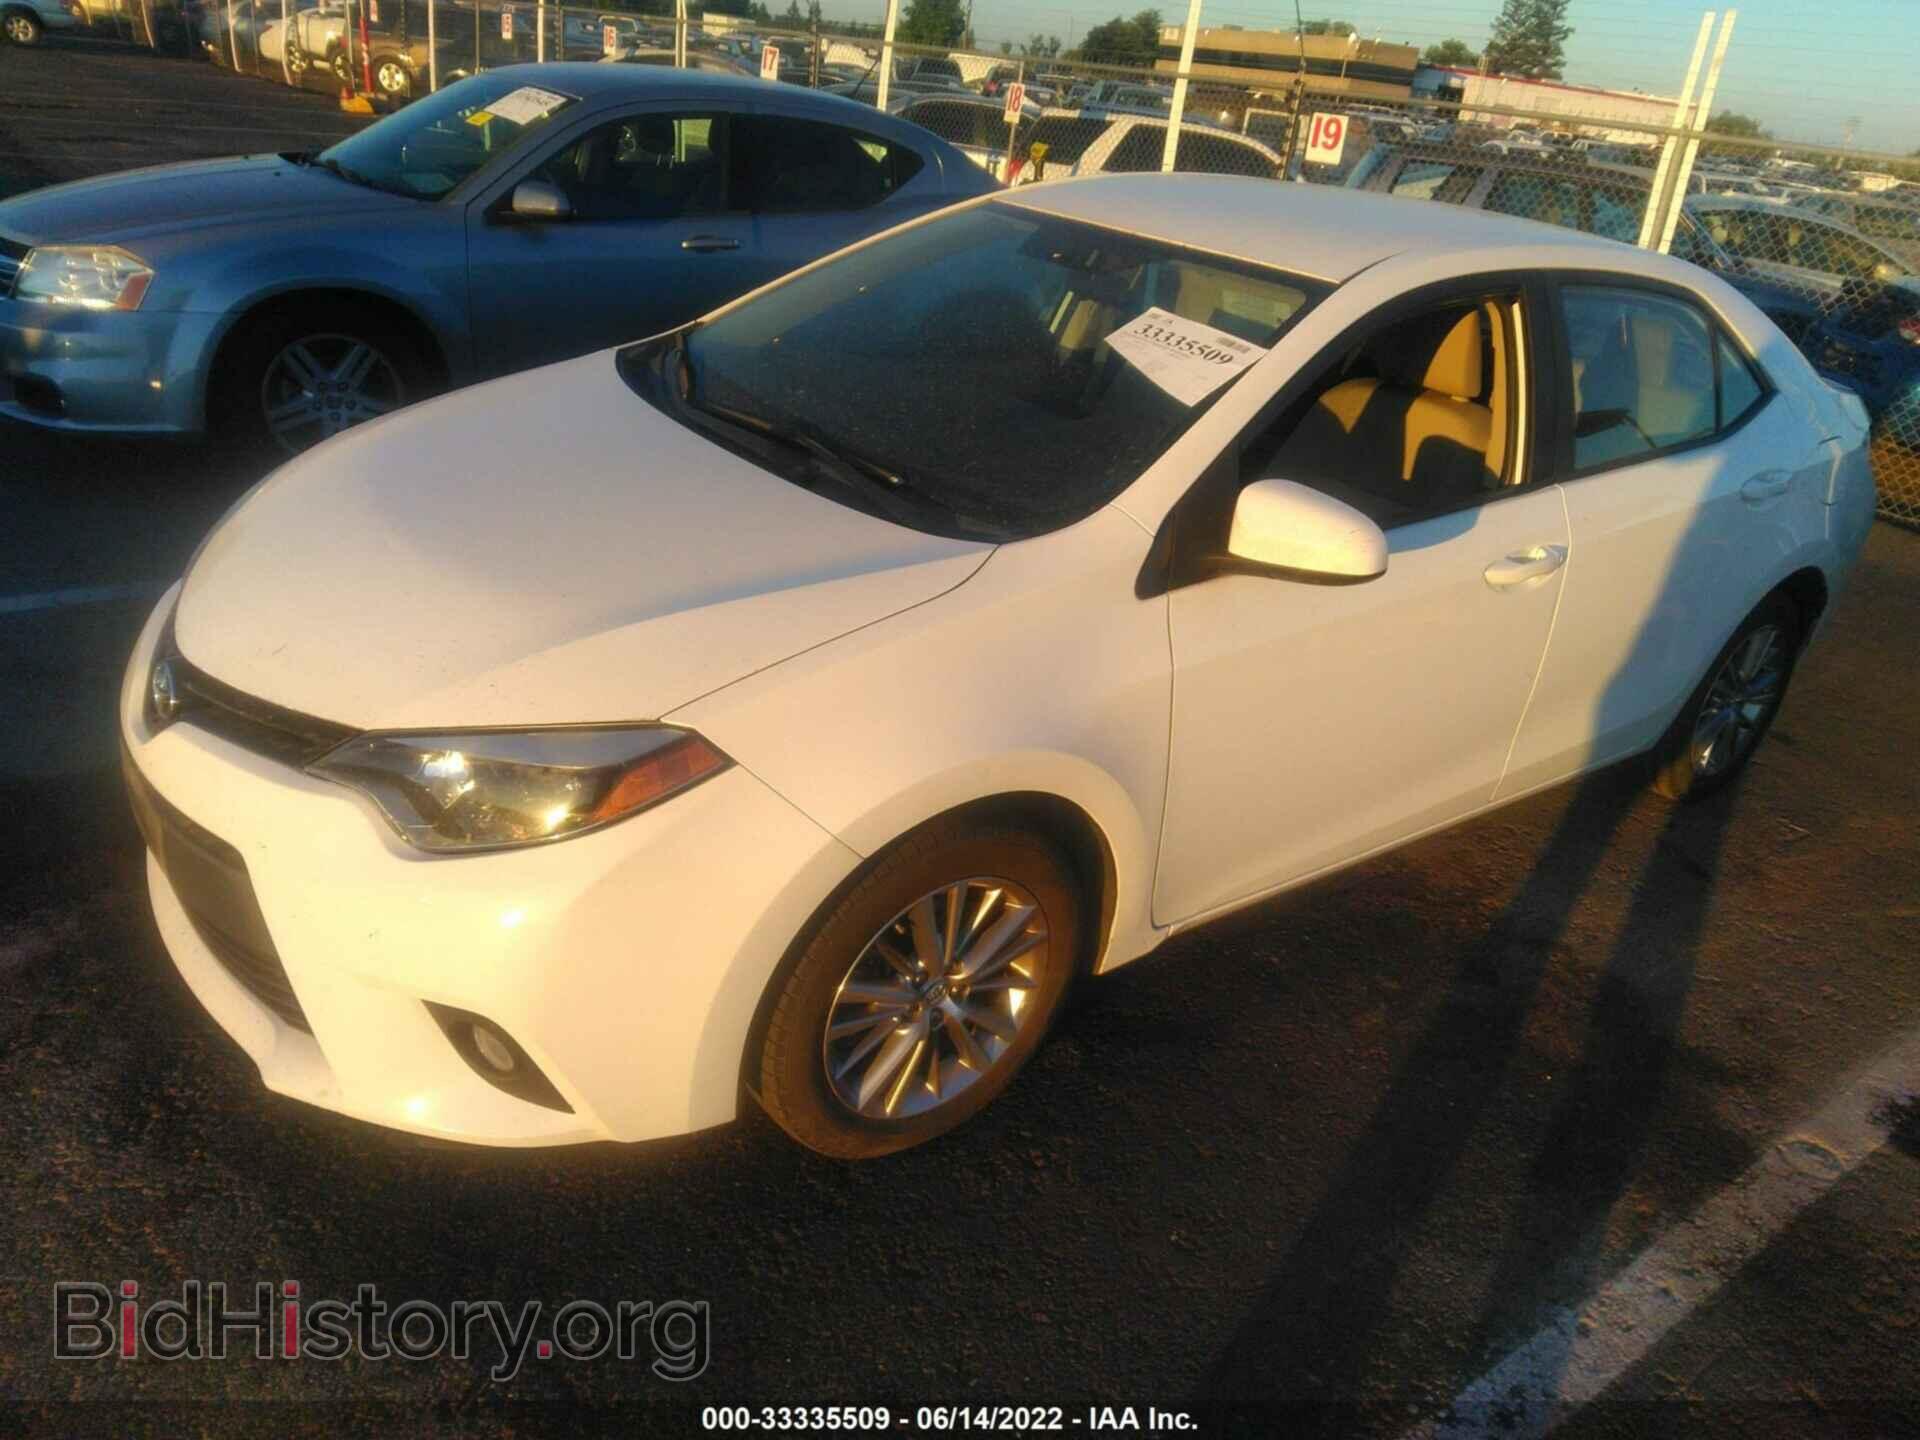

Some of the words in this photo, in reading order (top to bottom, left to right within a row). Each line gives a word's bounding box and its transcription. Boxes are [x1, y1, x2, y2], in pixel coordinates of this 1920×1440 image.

[763, 47, 778, 71] 17
[1007, 84, 1023, 113] 18
[1311, 117, 1343, 150] 19
[1133, 323, 1235, 365] 33335509
